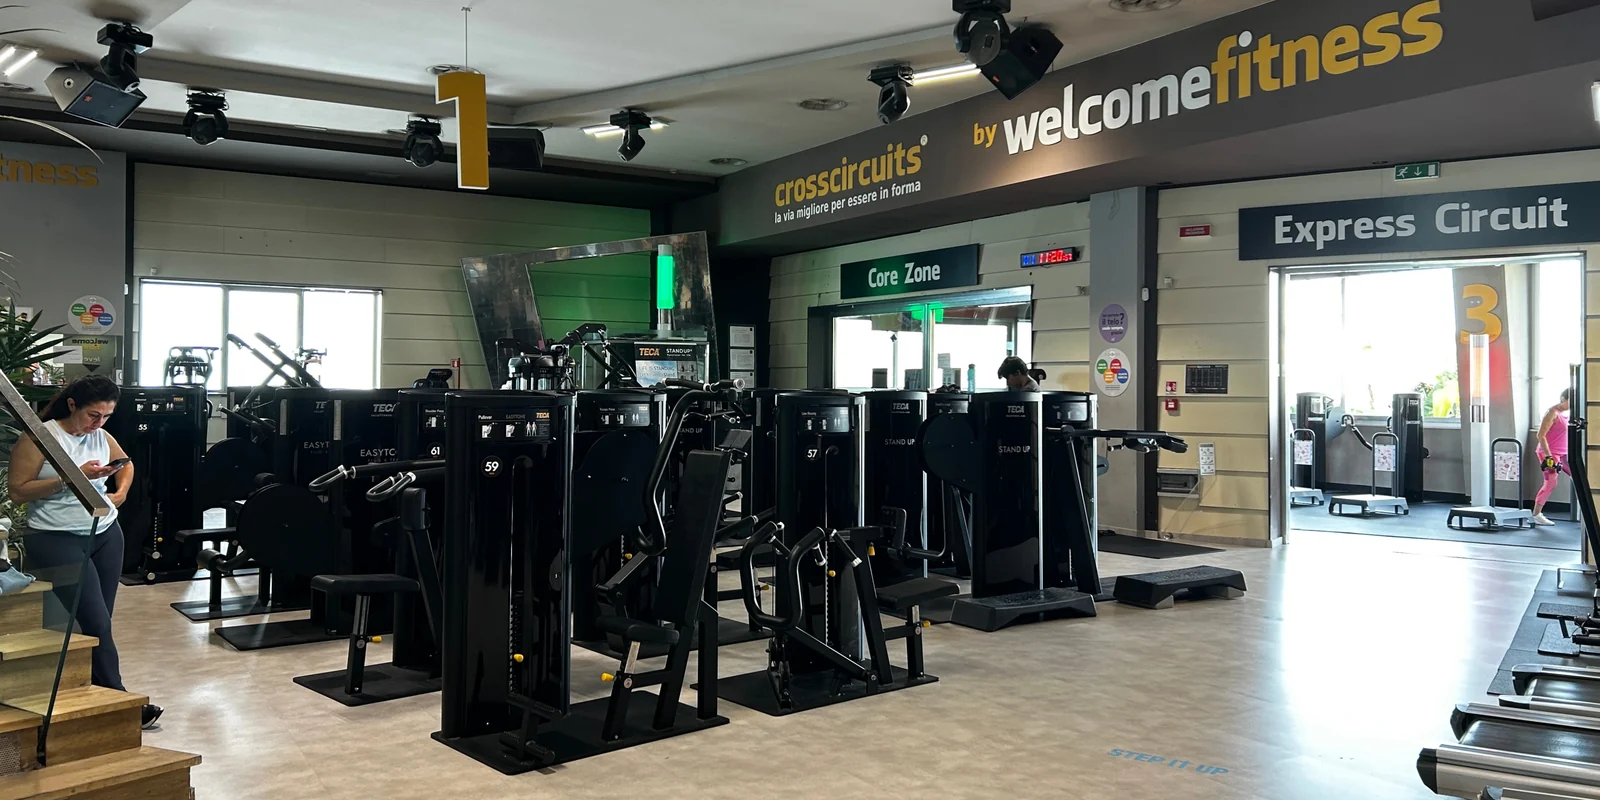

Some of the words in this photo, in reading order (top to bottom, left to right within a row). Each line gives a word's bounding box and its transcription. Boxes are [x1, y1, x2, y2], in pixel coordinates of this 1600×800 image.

[973, 122, 997, 149] by
[1002, 0, 1444, 156] welcomefitness
[435, 71, 490, 191] 1
[774, 212, 782, 224] la
[783, 209, 795, 222] via
[796, 202, 829, 220] migliore
[830, 198, 846, 214] per
[847, 191, 878, 207] essere
[879, 186, 889, 200] in
[890, 180, 922, 198] forma
[1274, 213, 1417, 250] Express
[1435, 197, 1569, 234] Circuit
[868, 267, 898, 288] Core
[904, 261, 941, 284] Zone
[1460, 283, 1502, 345] 3
[638, 347, 661, 357] TECA
[315, 400, 328, 409] TE
[892, 402, 910, 410] TECA
[1006, 405, 1025, 414] TECA
[137, 422, 149, 432] 55
[303, 441, 330, 449] EASYT
[884, 438, 906, 446] STAND
[906, 438, 915, 446] UP
[360, 447, 396, 457] EASYTO
[429, 446, 441, 457] 61
[807, 449, 818, 458] 57
[998, 445, 1022, 453] STAND
[1022, 445, 1031, 453] UP
[483, 460, 500, 473] 59
[1106, 748, 1166, 764] STEP
[1167, 759, 1194, 769] IT
[1195, 764, 1230, 775] UP
